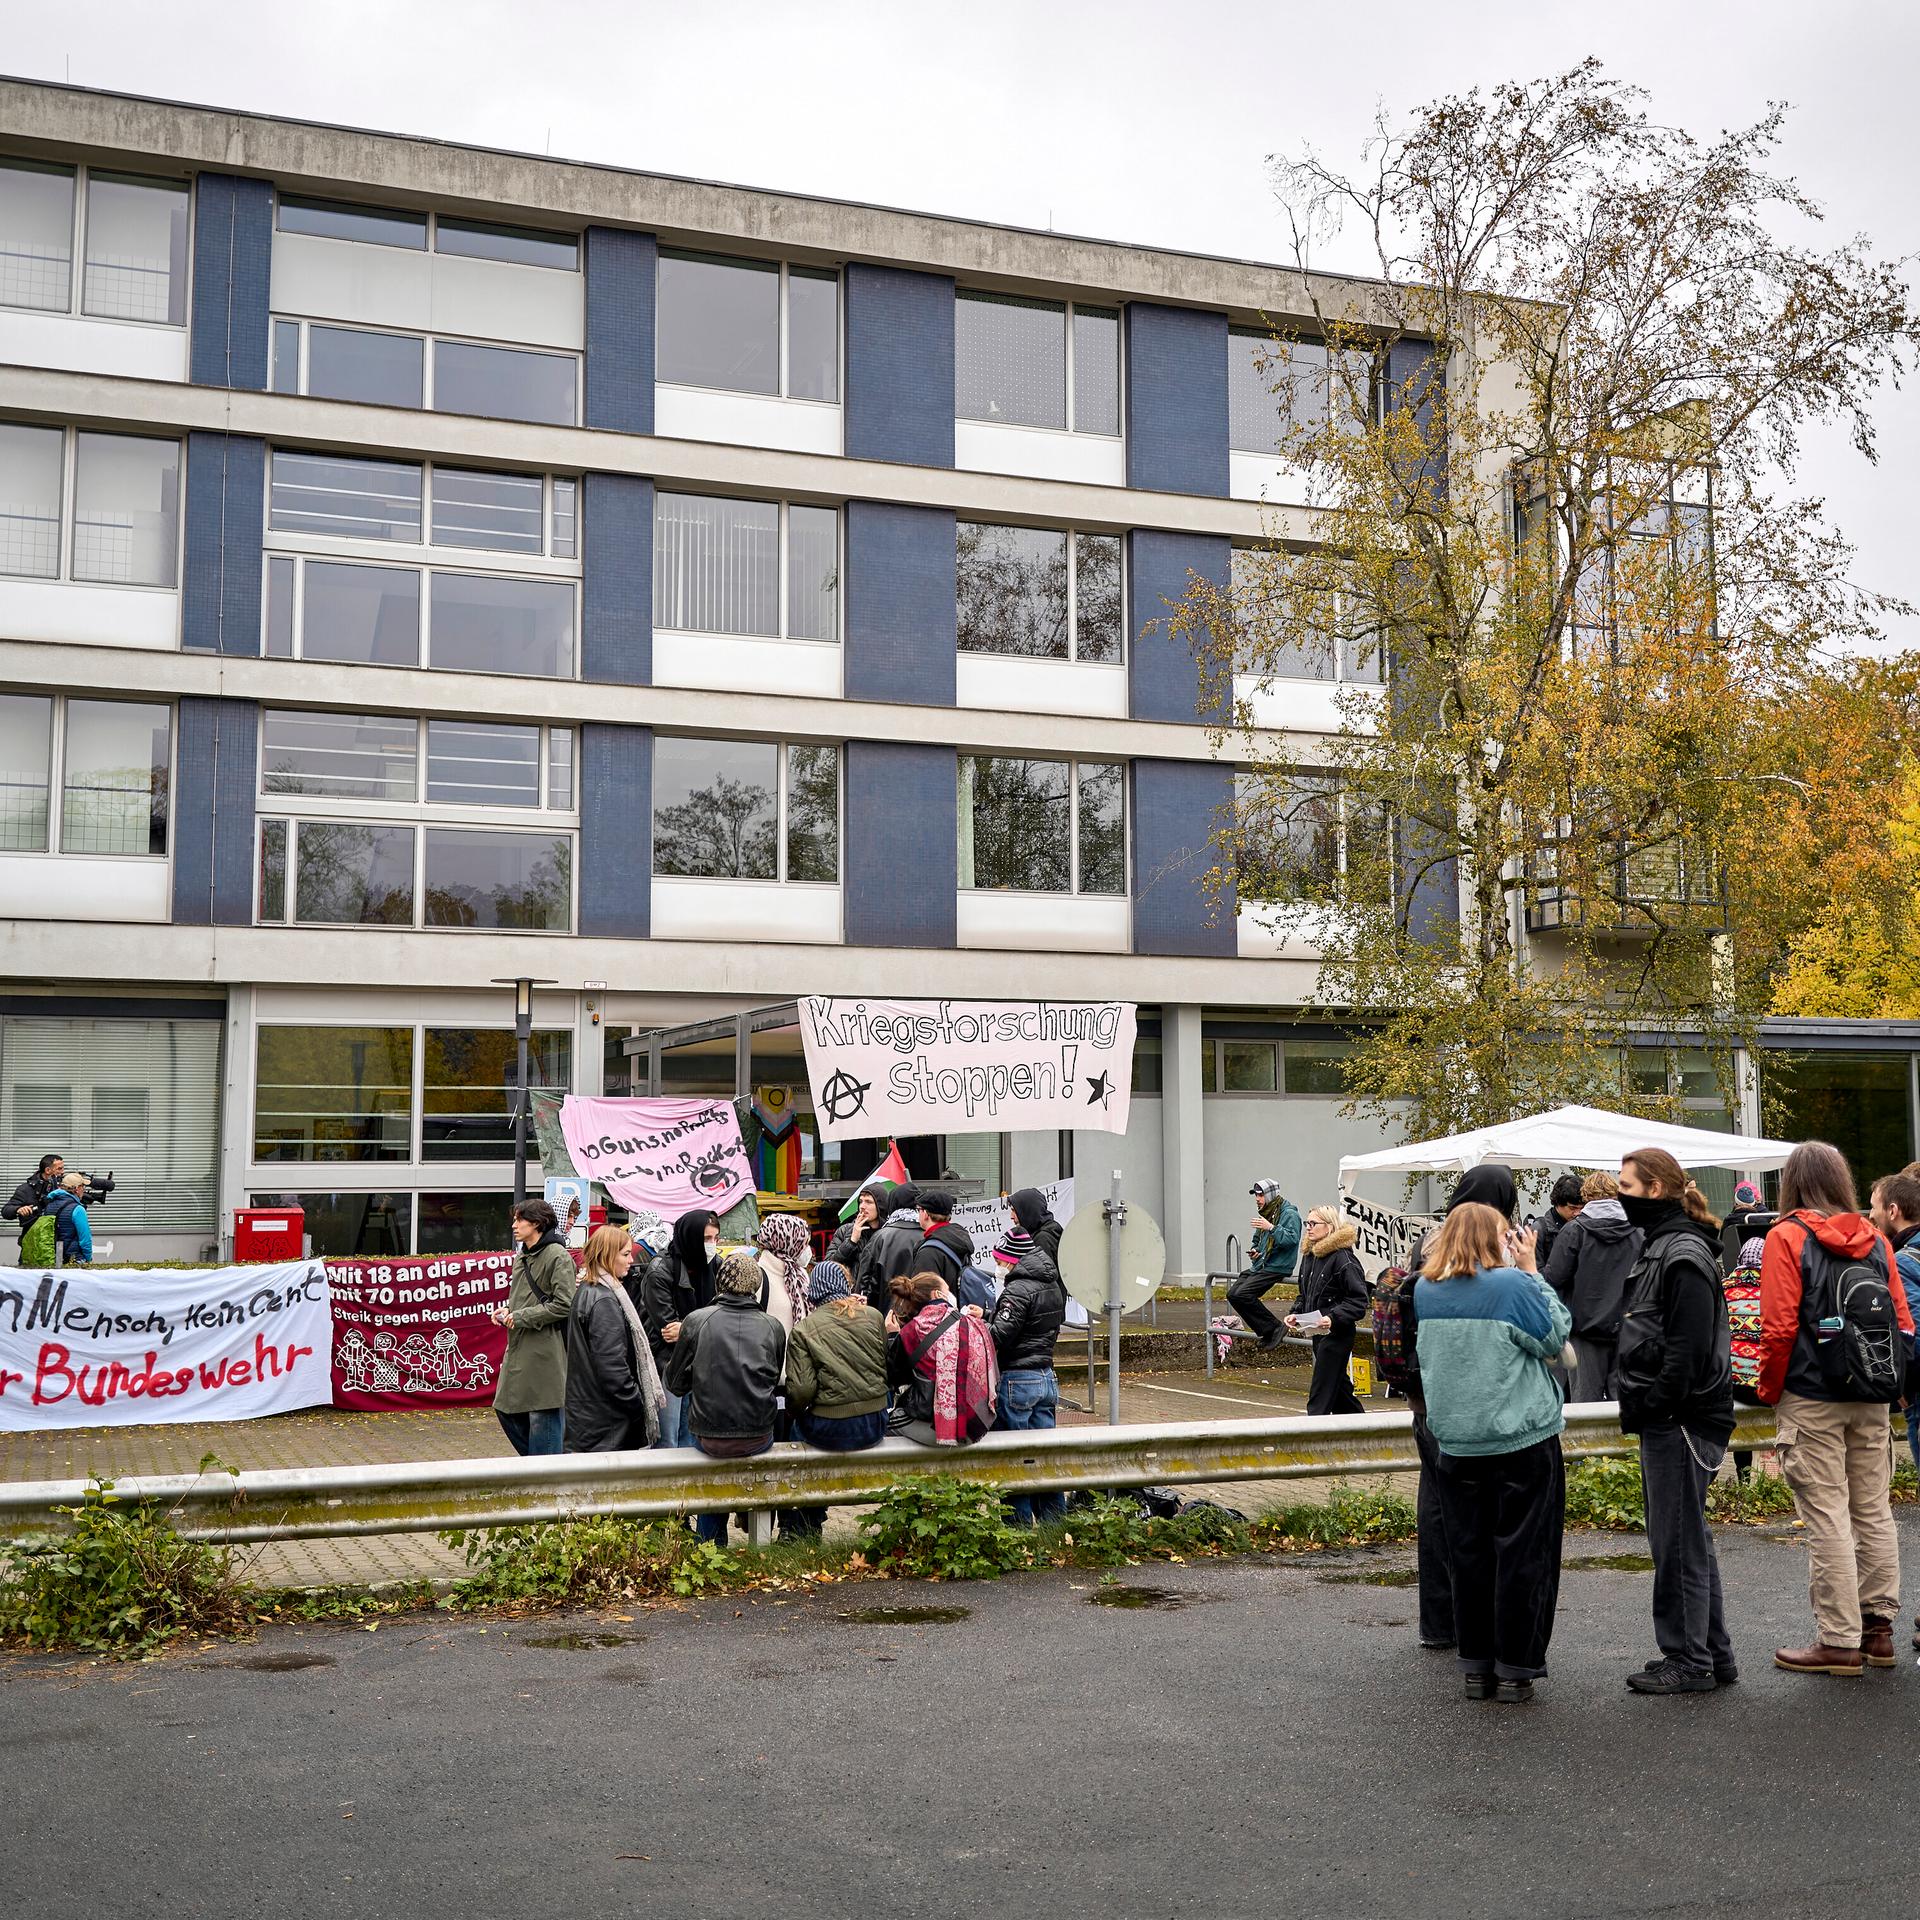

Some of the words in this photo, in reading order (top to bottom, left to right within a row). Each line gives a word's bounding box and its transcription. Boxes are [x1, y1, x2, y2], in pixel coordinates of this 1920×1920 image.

[808, 998, 1121, 1052] Kriegsforschung
[326, 1266, 363, 1284] Mit
[367, 1265, 391, 1284] 18
[396, 1266, 423, 1282] an
[427, 1261, 461, 1278] die
[330, 1287, 361, 1303] mit
[365, 1287, 394, 1305] 70
[398, 1281, 453, 1304] noch
[457, 1278, 489, 1297] am
[249, 1267, 324, 1317] Cent
[334, 1307, 371, 1323] Streik
[375, 1312, 419, 1327] gegen
[422, 1302, 494, 1324] Regierung
[32, 1333, 312, 1406] Bundeswehr
